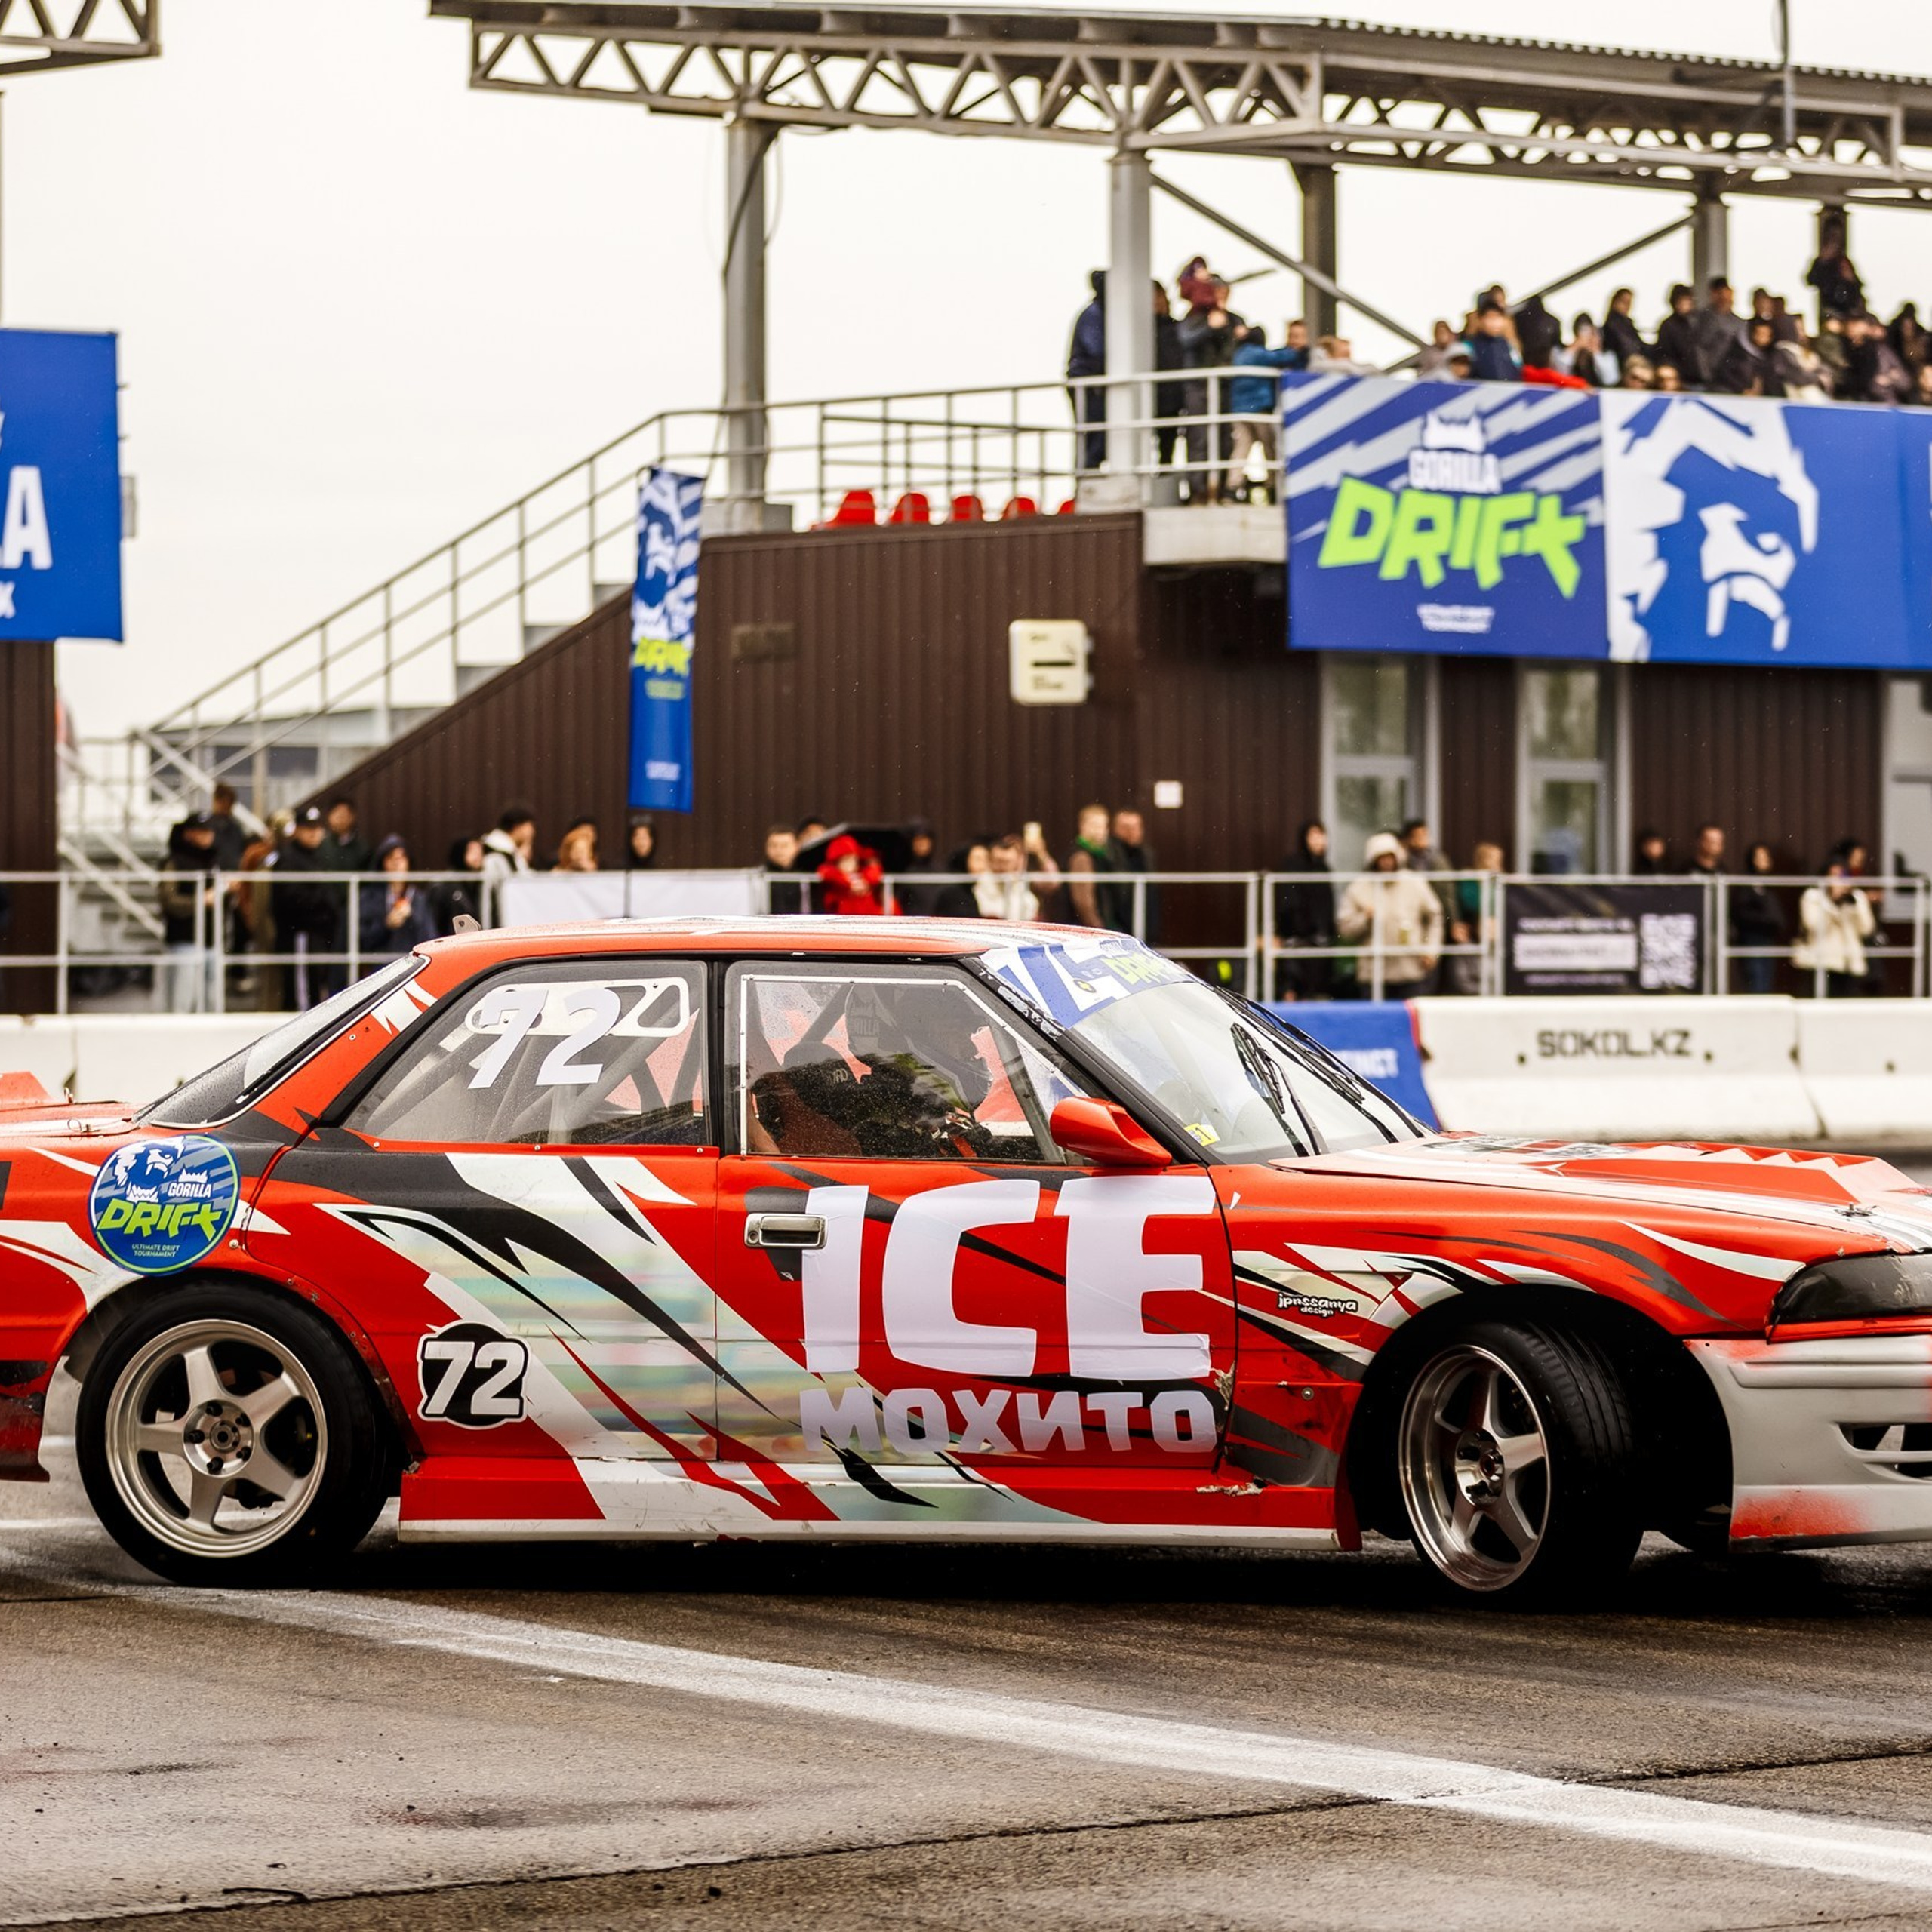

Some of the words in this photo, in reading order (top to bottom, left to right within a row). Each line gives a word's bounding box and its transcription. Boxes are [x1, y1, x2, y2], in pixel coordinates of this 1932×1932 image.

[0, 465, 53, 570] A
[1318, 475, 1586, 598] DRIFT
[467, 989, 621, 1089] 72
[97, 1198, 222, 1241] DRIFT
[168, 1183, 212, 1198] GORILLA
[801, 1175, 1216, 1380] ICE
[1300, 1306, 1334, 1318] design
[424, 1341, 525, 1415] 72
[799, 1386, 1217, 1452] МОХИТО
